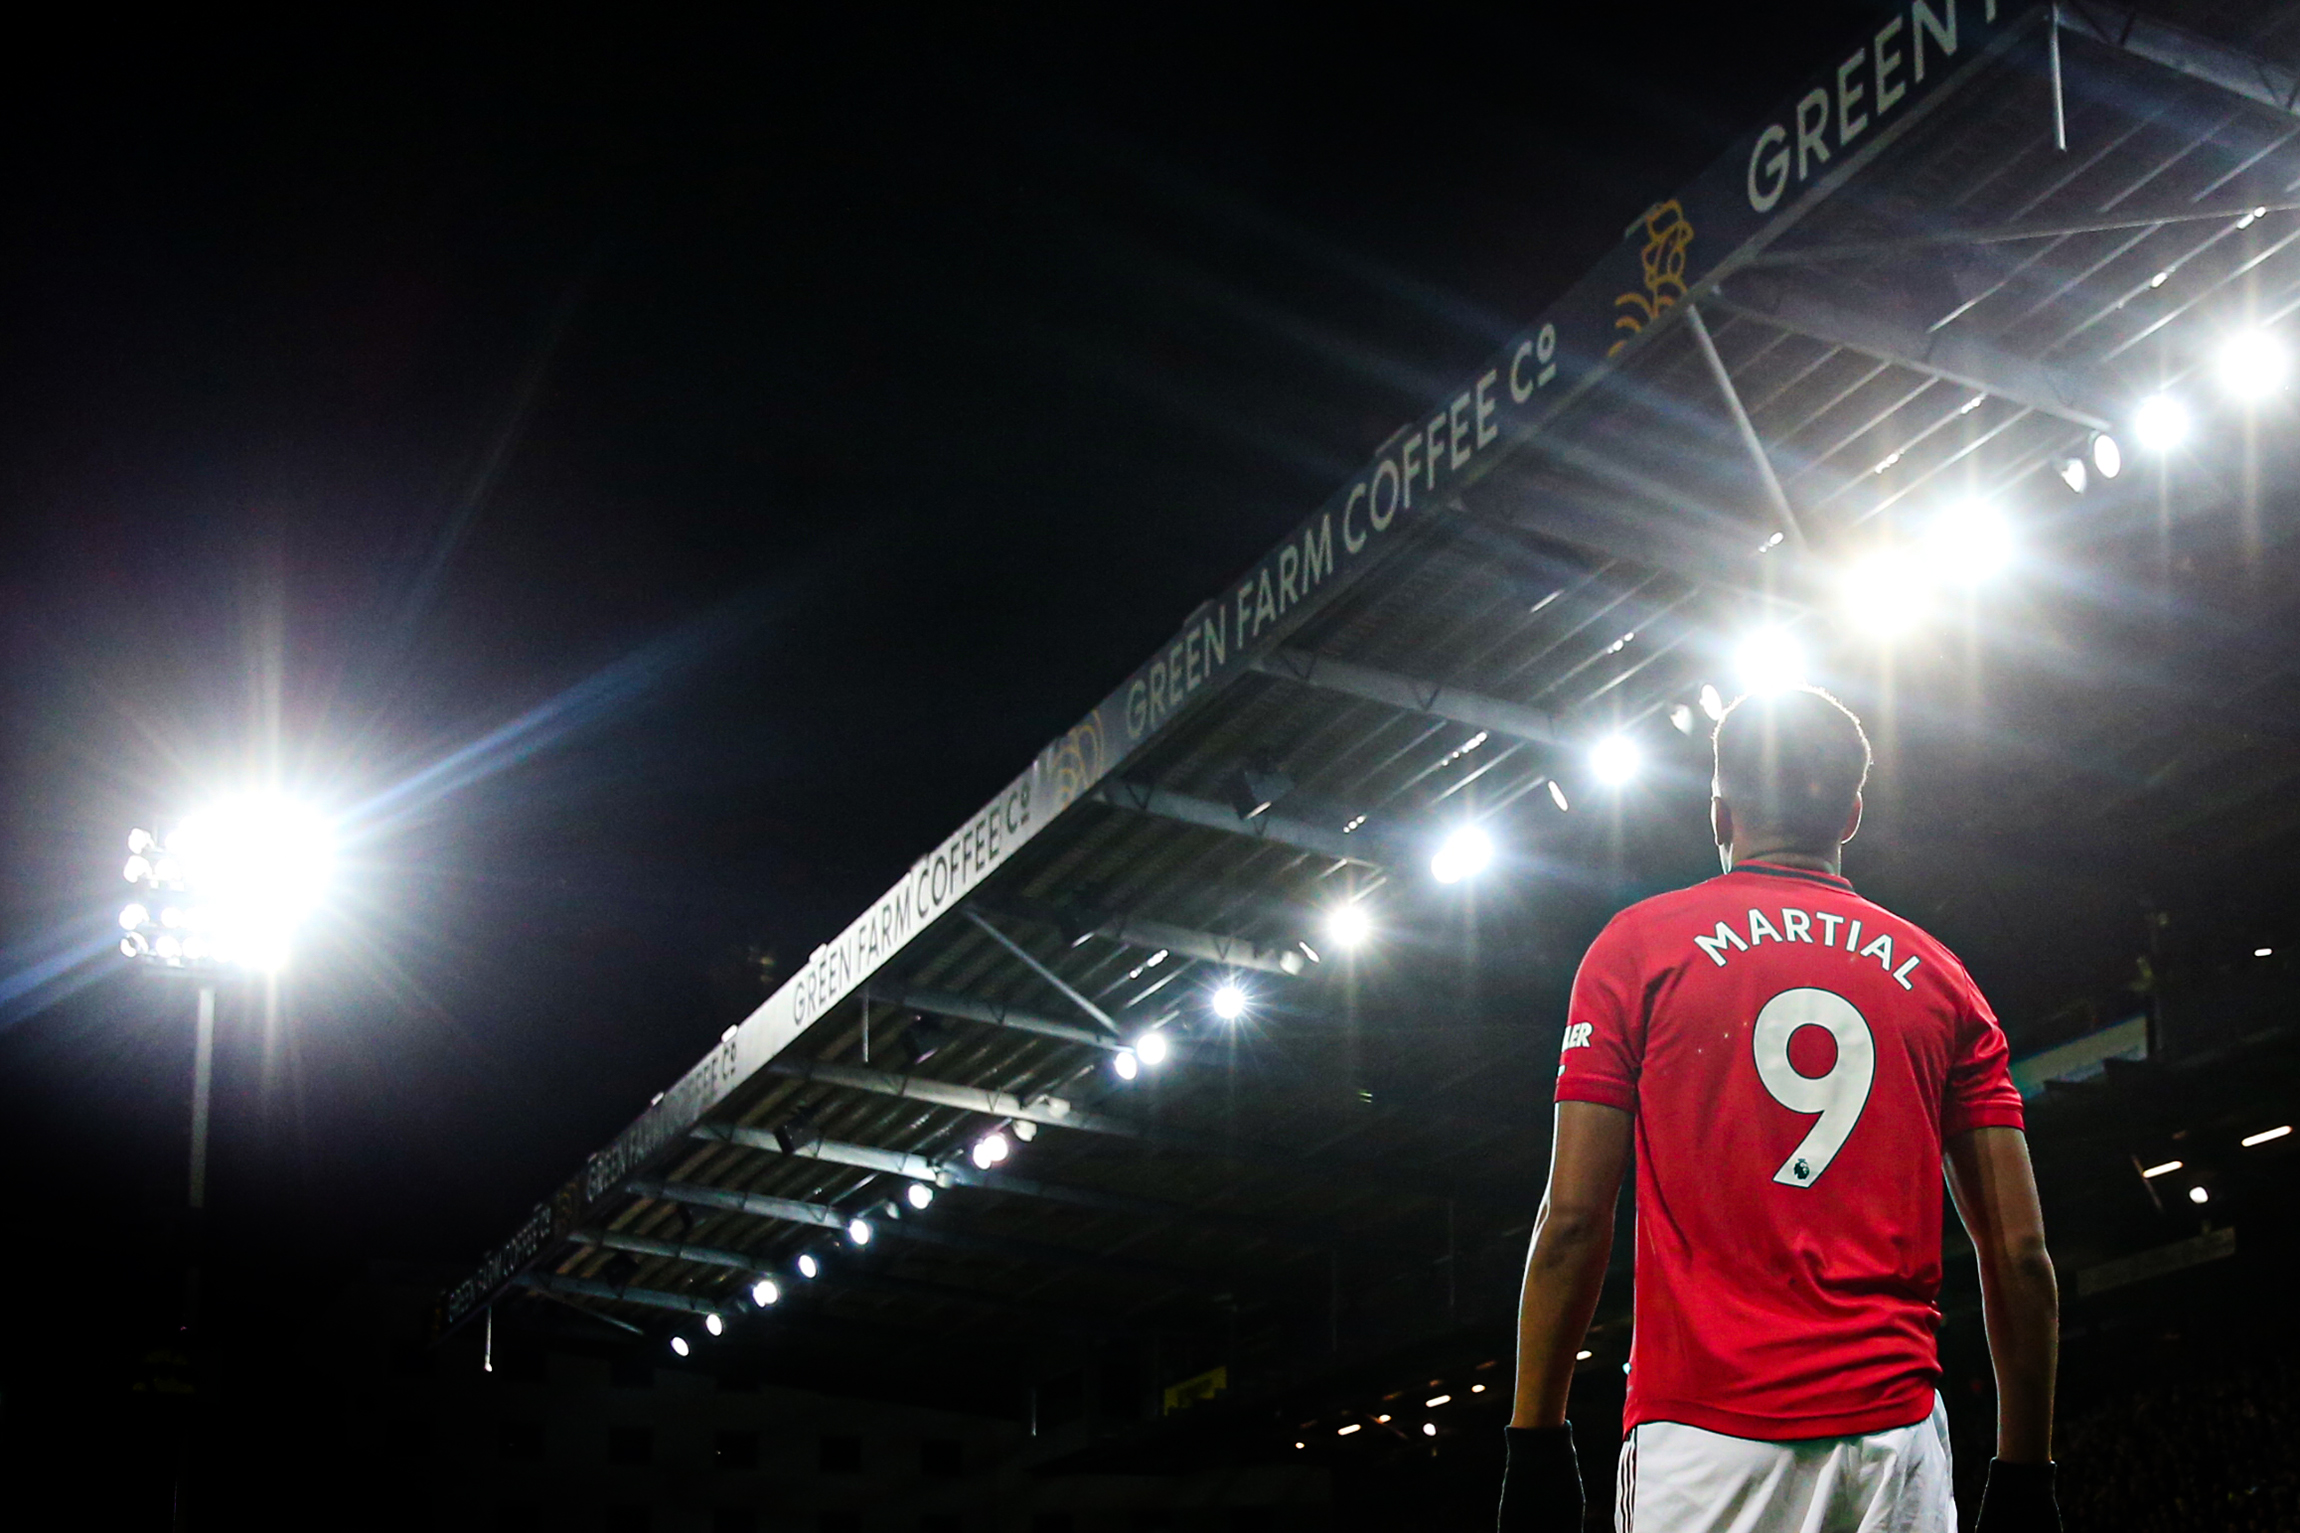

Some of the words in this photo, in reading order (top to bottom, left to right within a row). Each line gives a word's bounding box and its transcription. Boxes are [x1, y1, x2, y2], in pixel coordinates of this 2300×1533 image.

[1747, 0, 1958, 213] GREEN
[1124, 604, 1227, 739] GREEN
[1236, 513, 1334, 650] FARM
[1343, 369, 1498, 554] COFFEE
[793, 936, 852, 1026] GREEN
[858, 886, 911, 973] FARM
[916, 806, 1000, 919] COFFEE
[1694, 908, 1920, 991] MARTIAL
[1752, 986, 1876, 1189] 9
